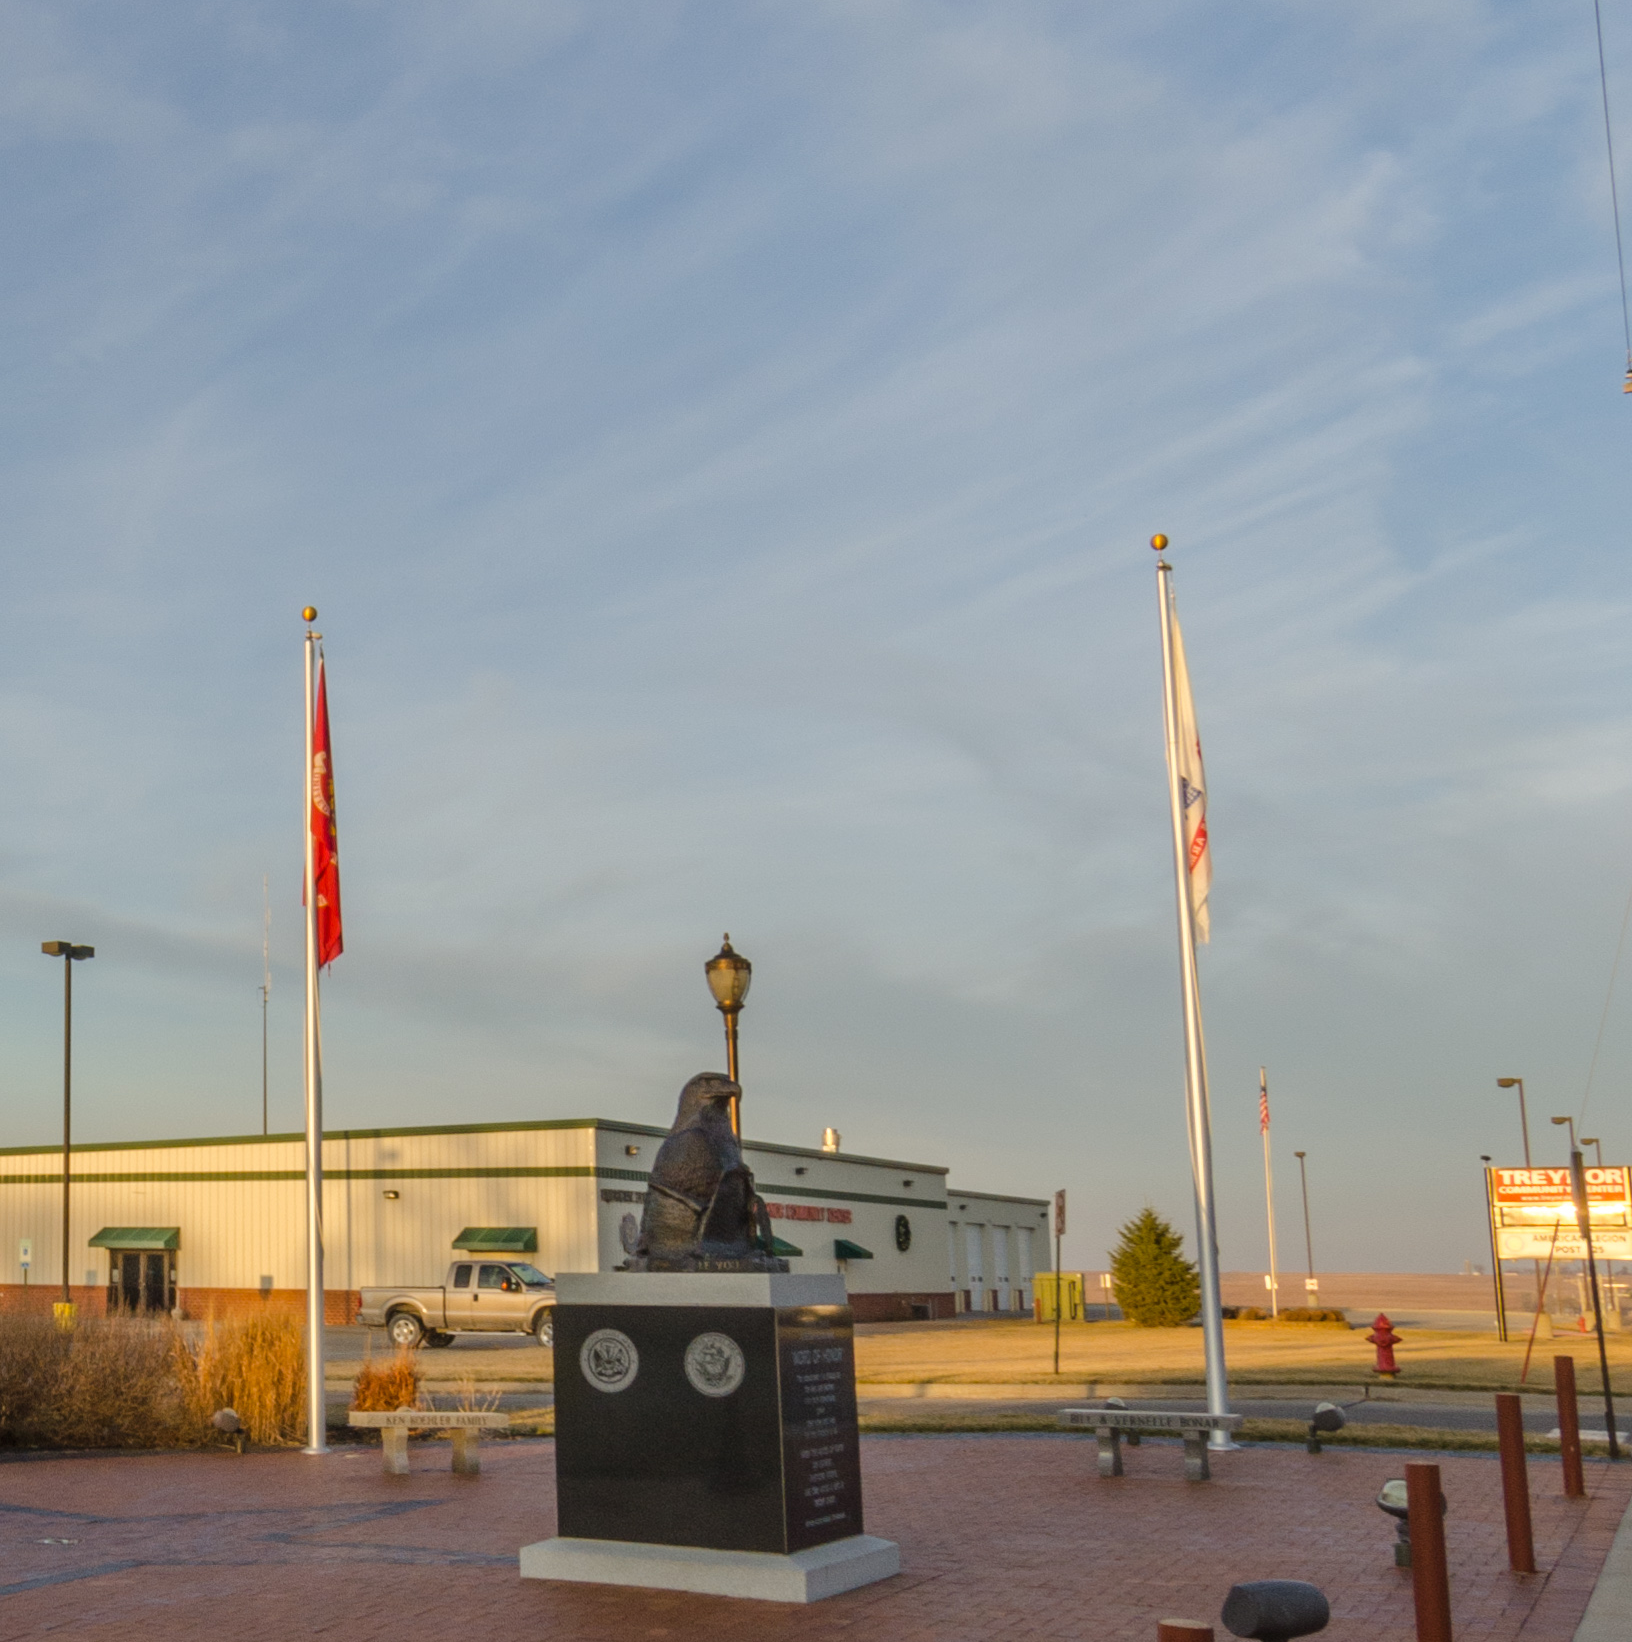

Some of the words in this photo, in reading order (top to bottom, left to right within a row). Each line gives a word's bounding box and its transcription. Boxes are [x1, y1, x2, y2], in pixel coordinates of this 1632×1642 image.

[1498, 1168, 1623, 1185] TREYOR
[1498, 1185, 1572, 1195] COMMUNITY
[1555, 1245, 1581, 1254] POST
[385, 1415, 406, 1426] KEN
[455, 1416, 487, 1426] FAMILY
